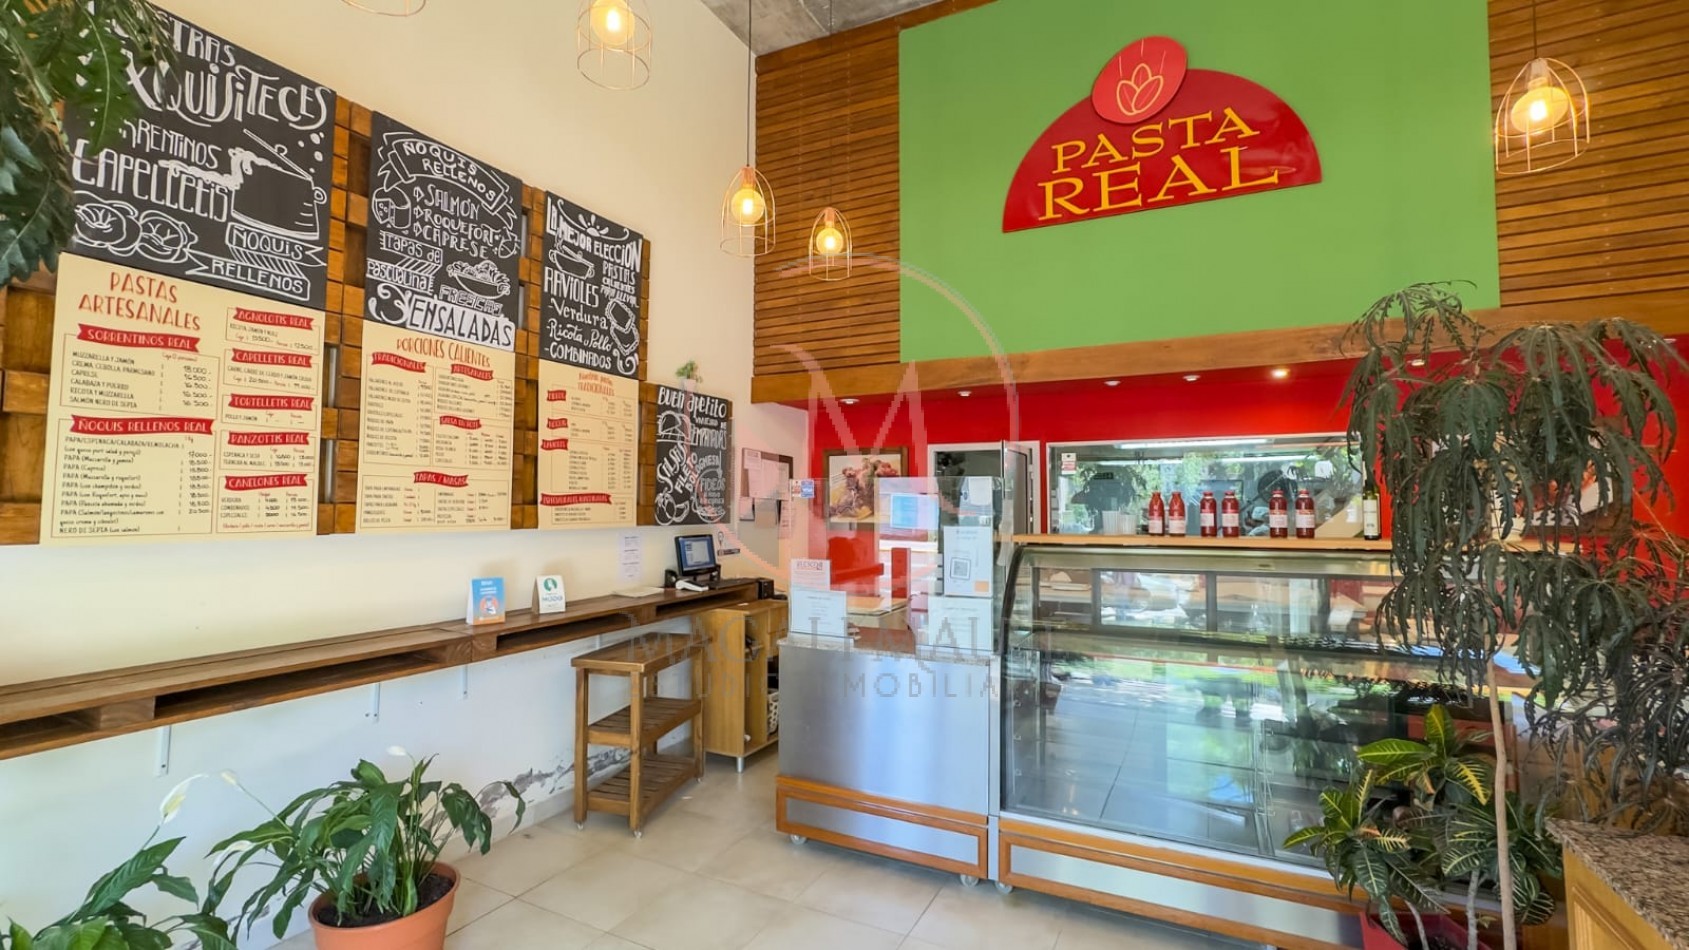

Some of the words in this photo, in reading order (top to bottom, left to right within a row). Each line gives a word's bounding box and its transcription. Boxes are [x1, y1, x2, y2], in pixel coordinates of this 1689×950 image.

[1051, 107, 1260, 174] PASTA
[422, 158, 496, 201] RELLENOS
[1037, 145, 1279, 221] REAL
[423, 225, 489, 259] CAPRESE
[558, 215, 592, 253] MEJOR
[110, 271, 178, 303] PASTAS
[211, 259, 304, 293] RELLENOS
[544, 267, 599, 308] RAVIOLES
[78, 294, 201, 331] ARTESANALES
[290, 317, 309, 327] REAL
[409, 299, 513, 347] ENSALADAS
[87, 329, 164, 346] SORRENTINOS
[168, 337, 193, 349] REAL
[396, 338, 445, 359] PORCIONES
[448, 342, 491, 368] CALIENTES
[236, 352, 285, 363] CAPELLETIS
[289, 356, 306, 366] REAL
[550, 342, 612, 370] COMBINADOS
[291, 398, 309, 408] REAL
[78, 419, 123, 432] ÑOQUIS
[128, 421, 180, 432] RELLENOS
[184, 421, 208, 433] REAL
[286, 434, 304, 443] REAL
[282, 476, 301, 485] REAL
